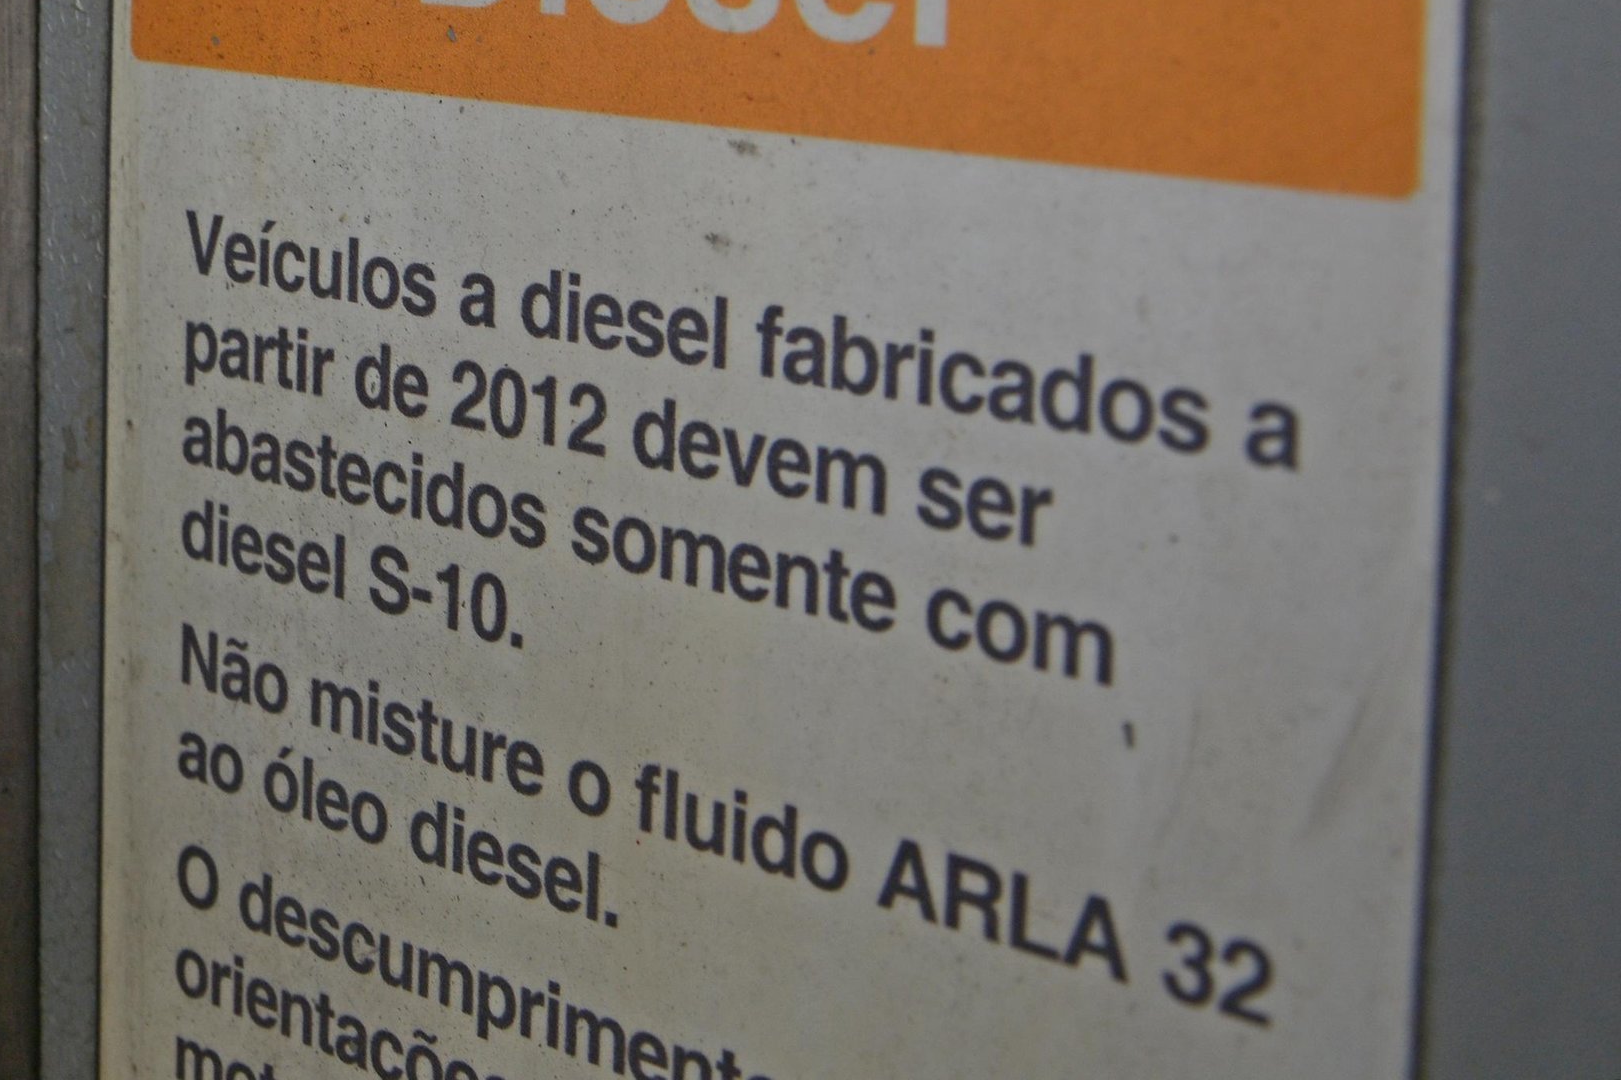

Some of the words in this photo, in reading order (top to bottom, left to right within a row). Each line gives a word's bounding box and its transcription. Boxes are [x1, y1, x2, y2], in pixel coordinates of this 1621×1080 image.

[184, 321, 334, 397] partir
[355, 343, 429, 419] de
[450, 360, 607, 458] 2012
[632, 397, 887, 516] devem
[917, 467, 1054, 547] ser
[185, 210, 437, 318] Veículos
[460, 273, 496, 329] a
[520, 269, 729, 370] diesel
[756, 304, 1210, 454] fabricados
[1246, 401, 1299, 471] a
[181, 500, 346, 601] diesel
[369, 544, 523, 649] S-10.
[182, 407, 547, 549] abastecidos
[571, 506, 896, 633] somente
[926, 588, 1114, 687] com
[177, 732, 244, 794] ao
[263, 746, 388, 845] óleo
[410, 800, 618, 927] diesel.
[181, 622, 289, 715] Não
[310, 677, 544, 797] misture
[568, 760, 611, 818] o
[634, 763, 849, 892] fluido
[877, 838, 1128, 984] ARLA
[1163, 922, 1273, 1028] 32
[176, 845, 219, 911] O
[239, 873, 773, 1080] descumpriment
